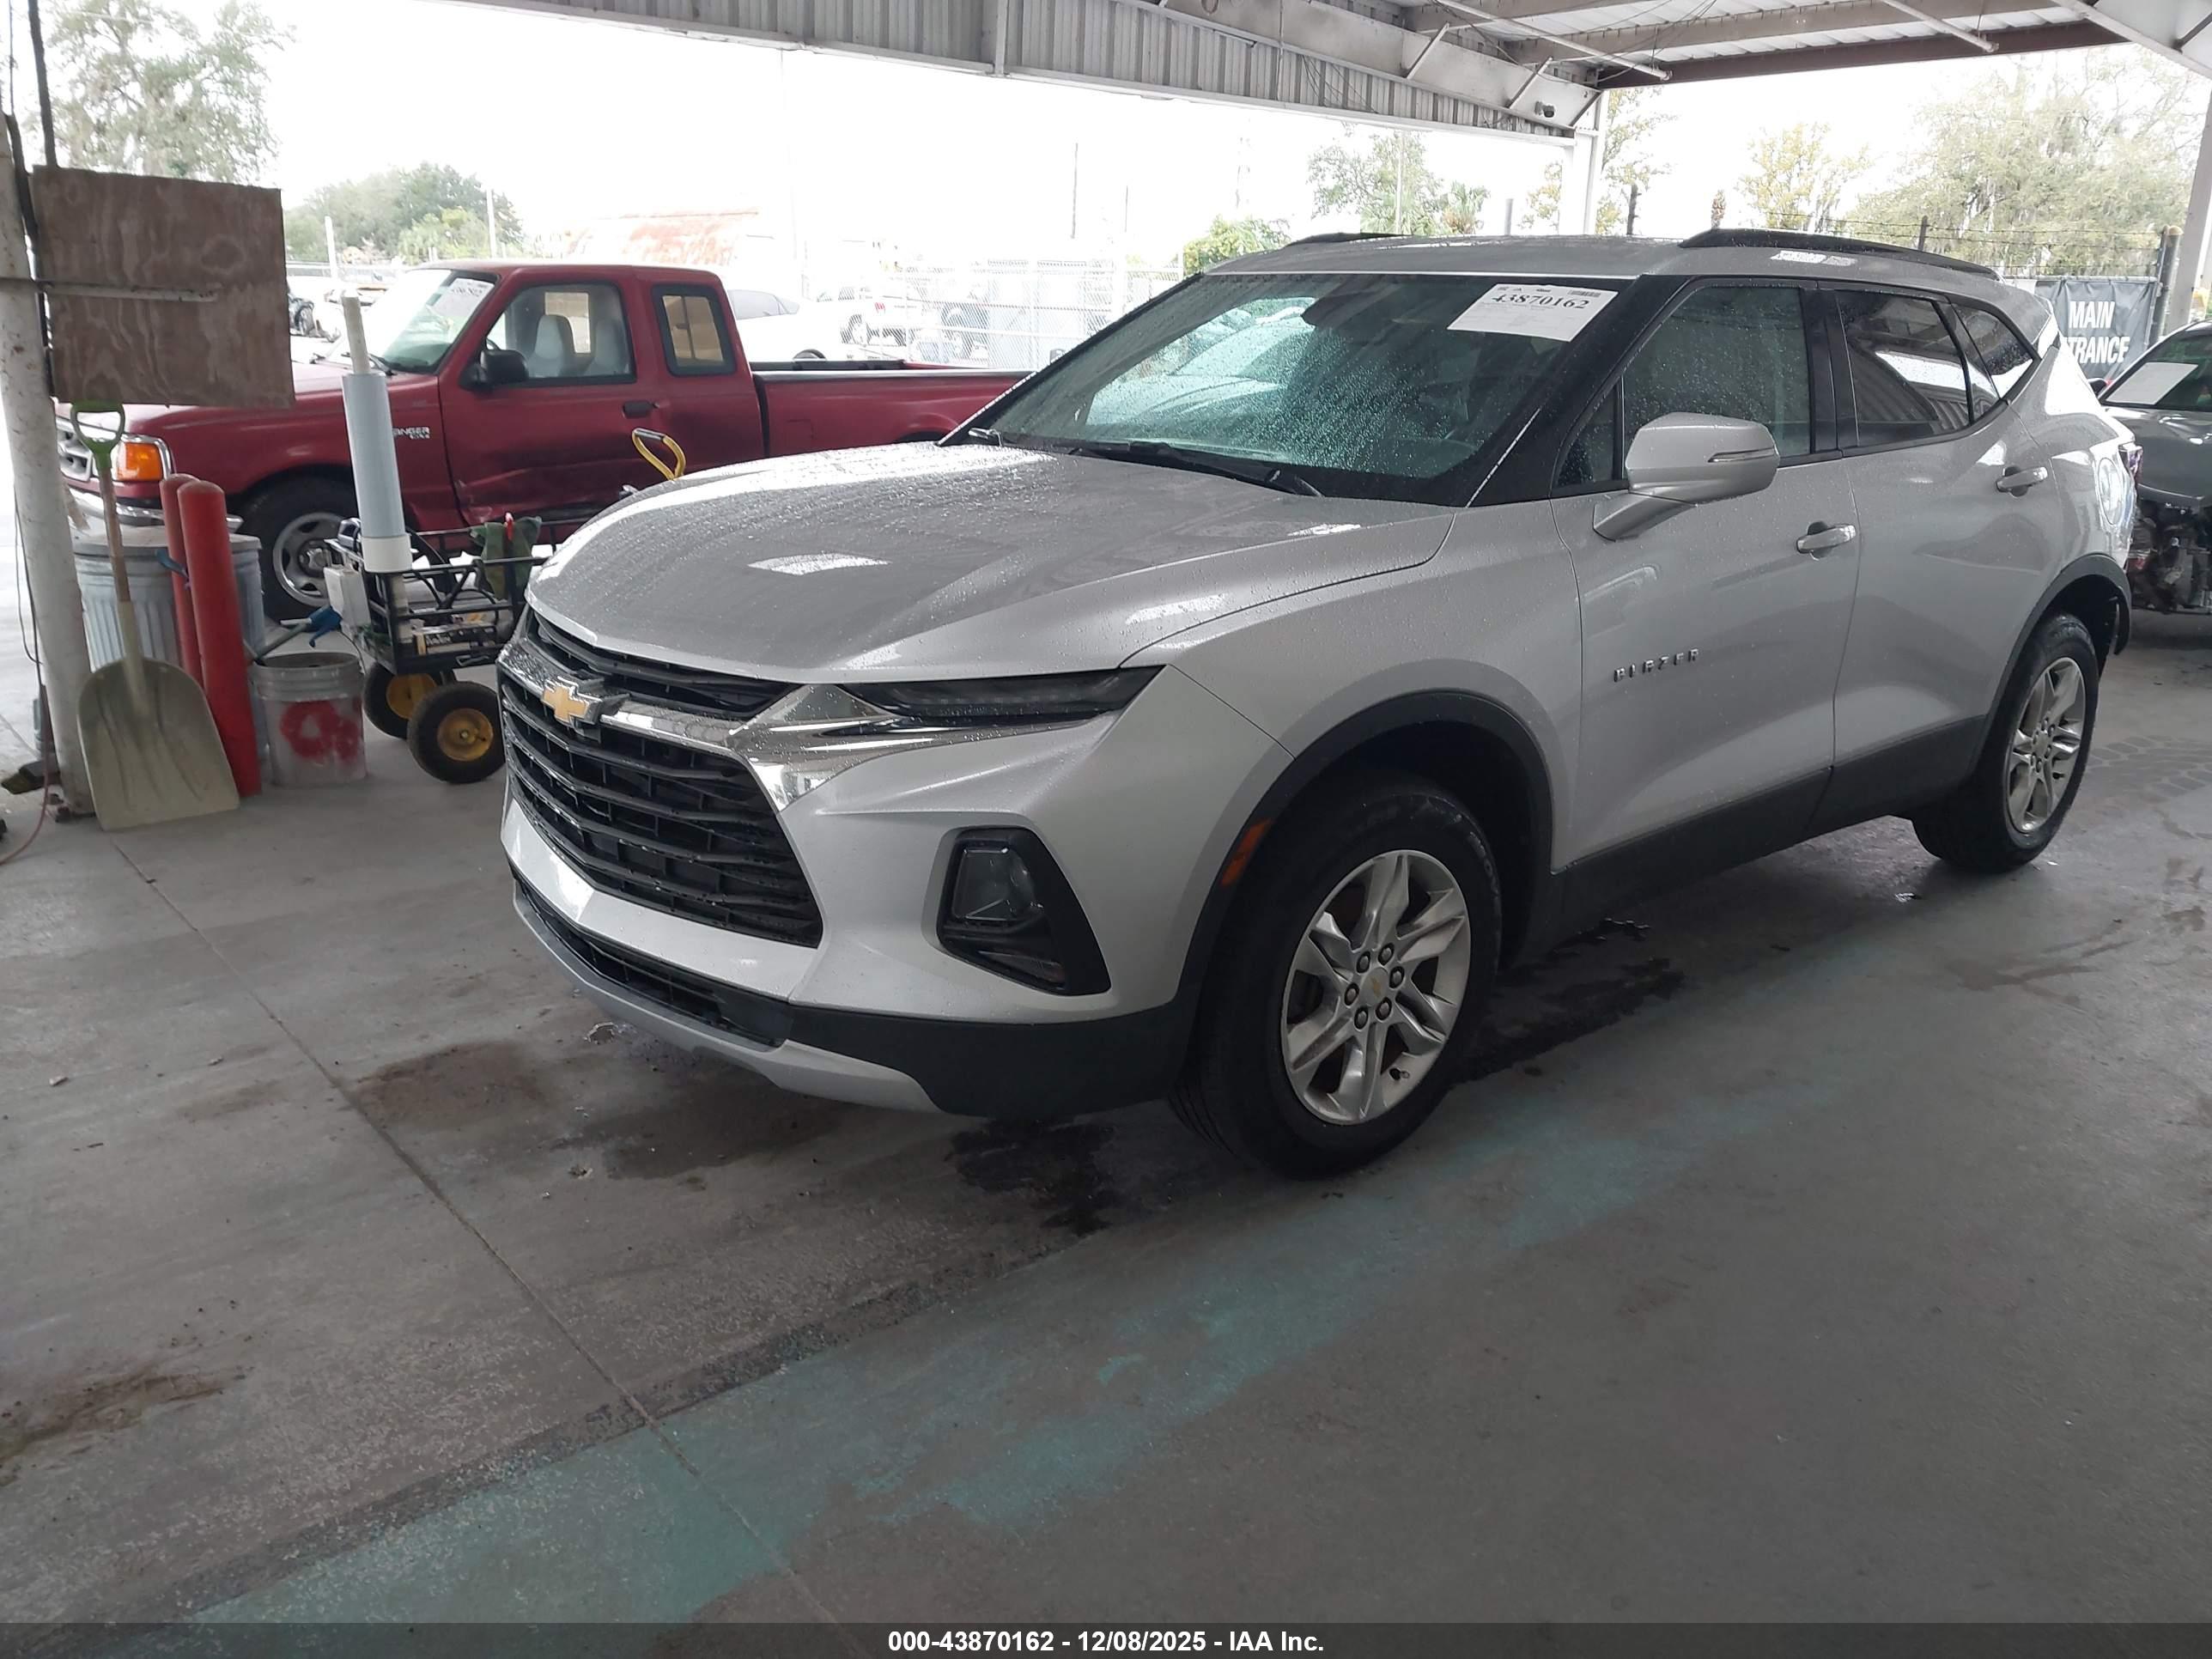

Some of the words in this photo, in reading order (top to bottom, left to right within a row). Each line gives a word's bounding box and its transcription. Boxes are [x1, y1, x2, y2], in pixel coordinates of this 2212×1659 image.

[1492, 294, 1589, 309] 43870162
[2069, 301, 2116, 329] MAIN
[2062, 336, 2130, 364] TRANCE
[392, 427, 430, 435] ANGER
